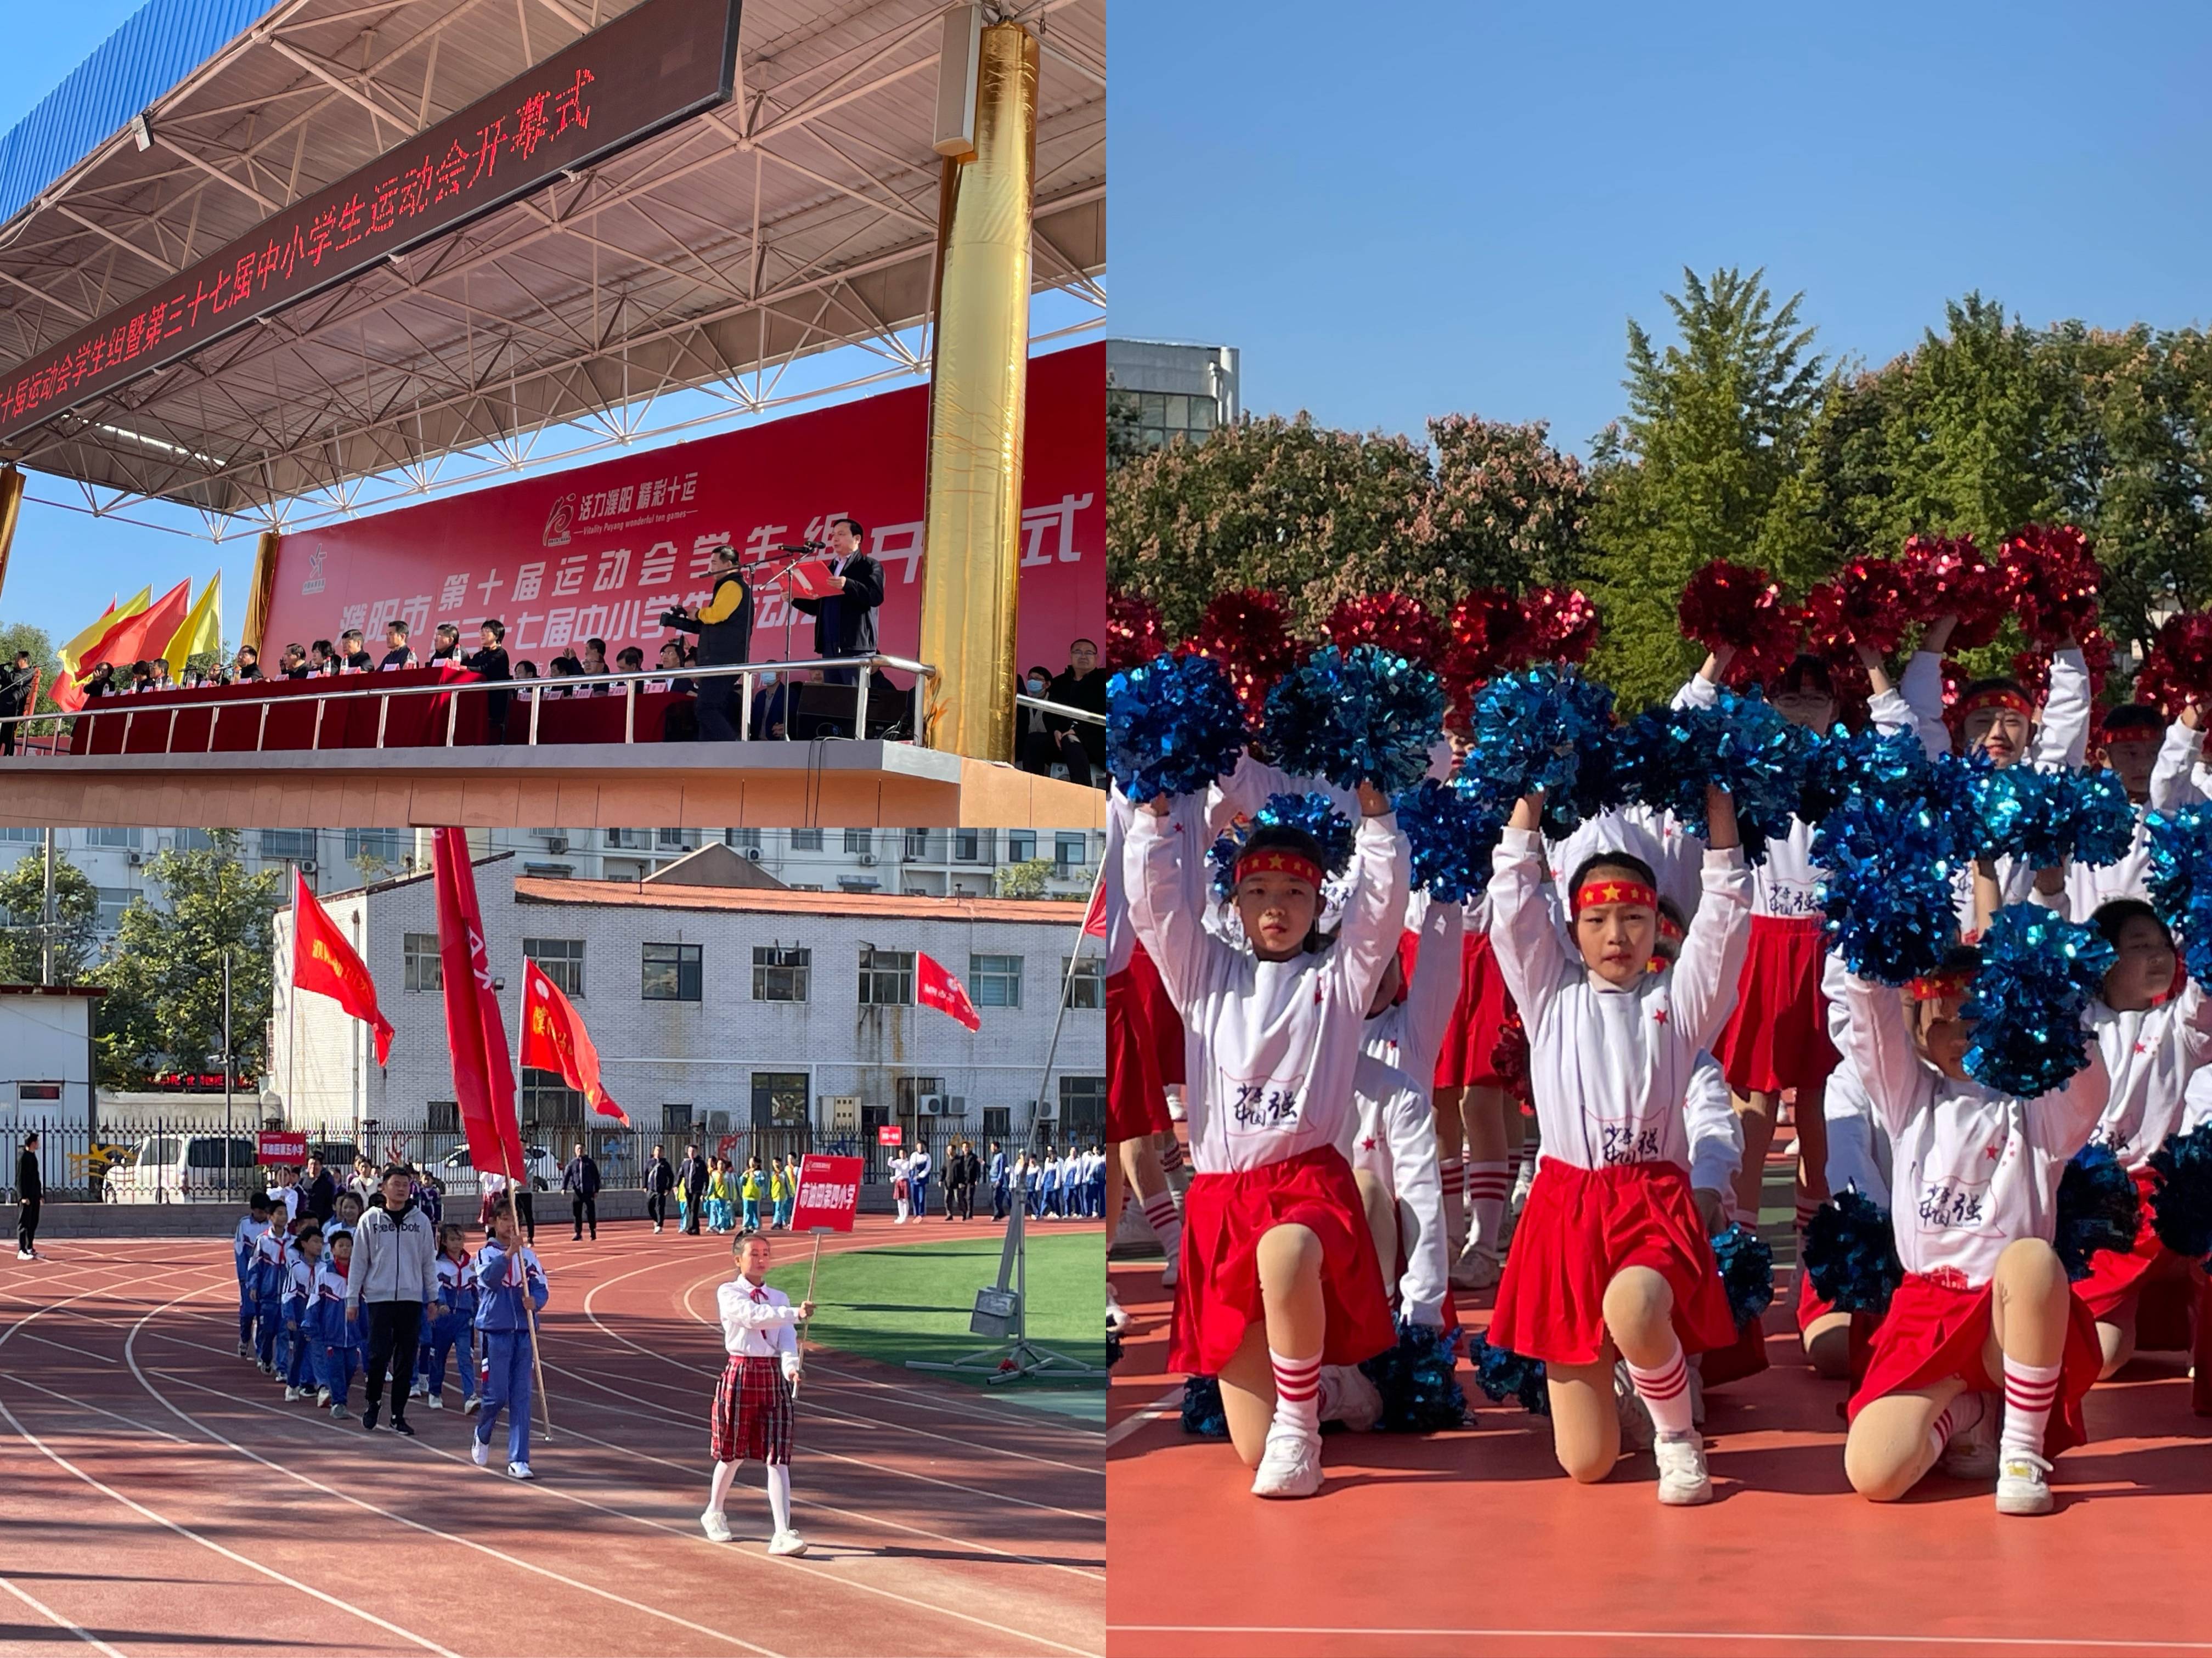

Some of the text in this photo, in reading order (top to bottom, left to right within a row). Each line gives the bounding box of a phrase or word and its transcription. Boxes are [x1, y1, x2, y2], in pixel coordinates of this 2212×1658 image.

[578, 472, 698, 521] 活力濮阳 精彩十运
[604, 521, 624, 533] Puyang
[625, 514, 654, 528] wonderful
[656, 514, 665, 522] ten
[799, 1181, 856, 1210] 市油田第四小学
